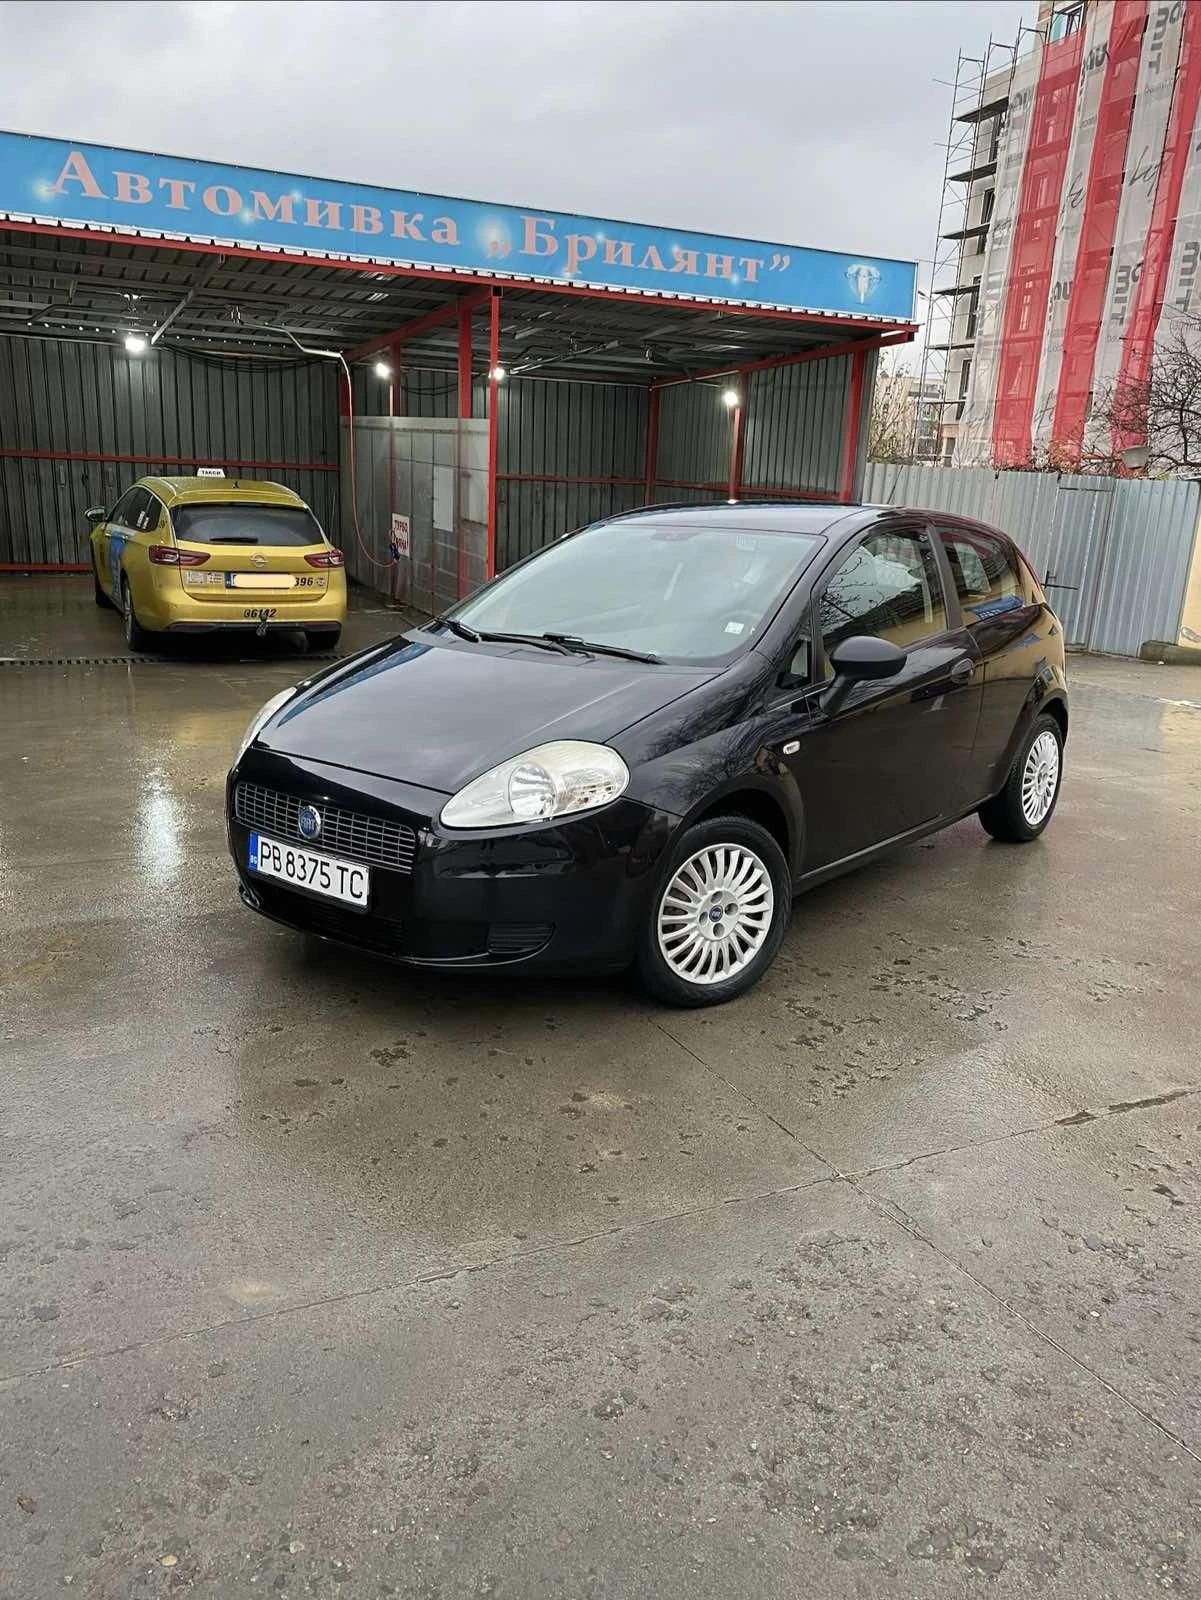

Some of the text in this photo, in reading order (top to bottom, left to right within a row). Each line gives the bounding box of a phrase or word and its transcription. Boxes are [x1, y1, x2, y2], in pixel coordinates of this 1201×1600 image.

[50, 150, 461, 246] Автомивка
[260, 841, 363, 899] PB 8375 TC
